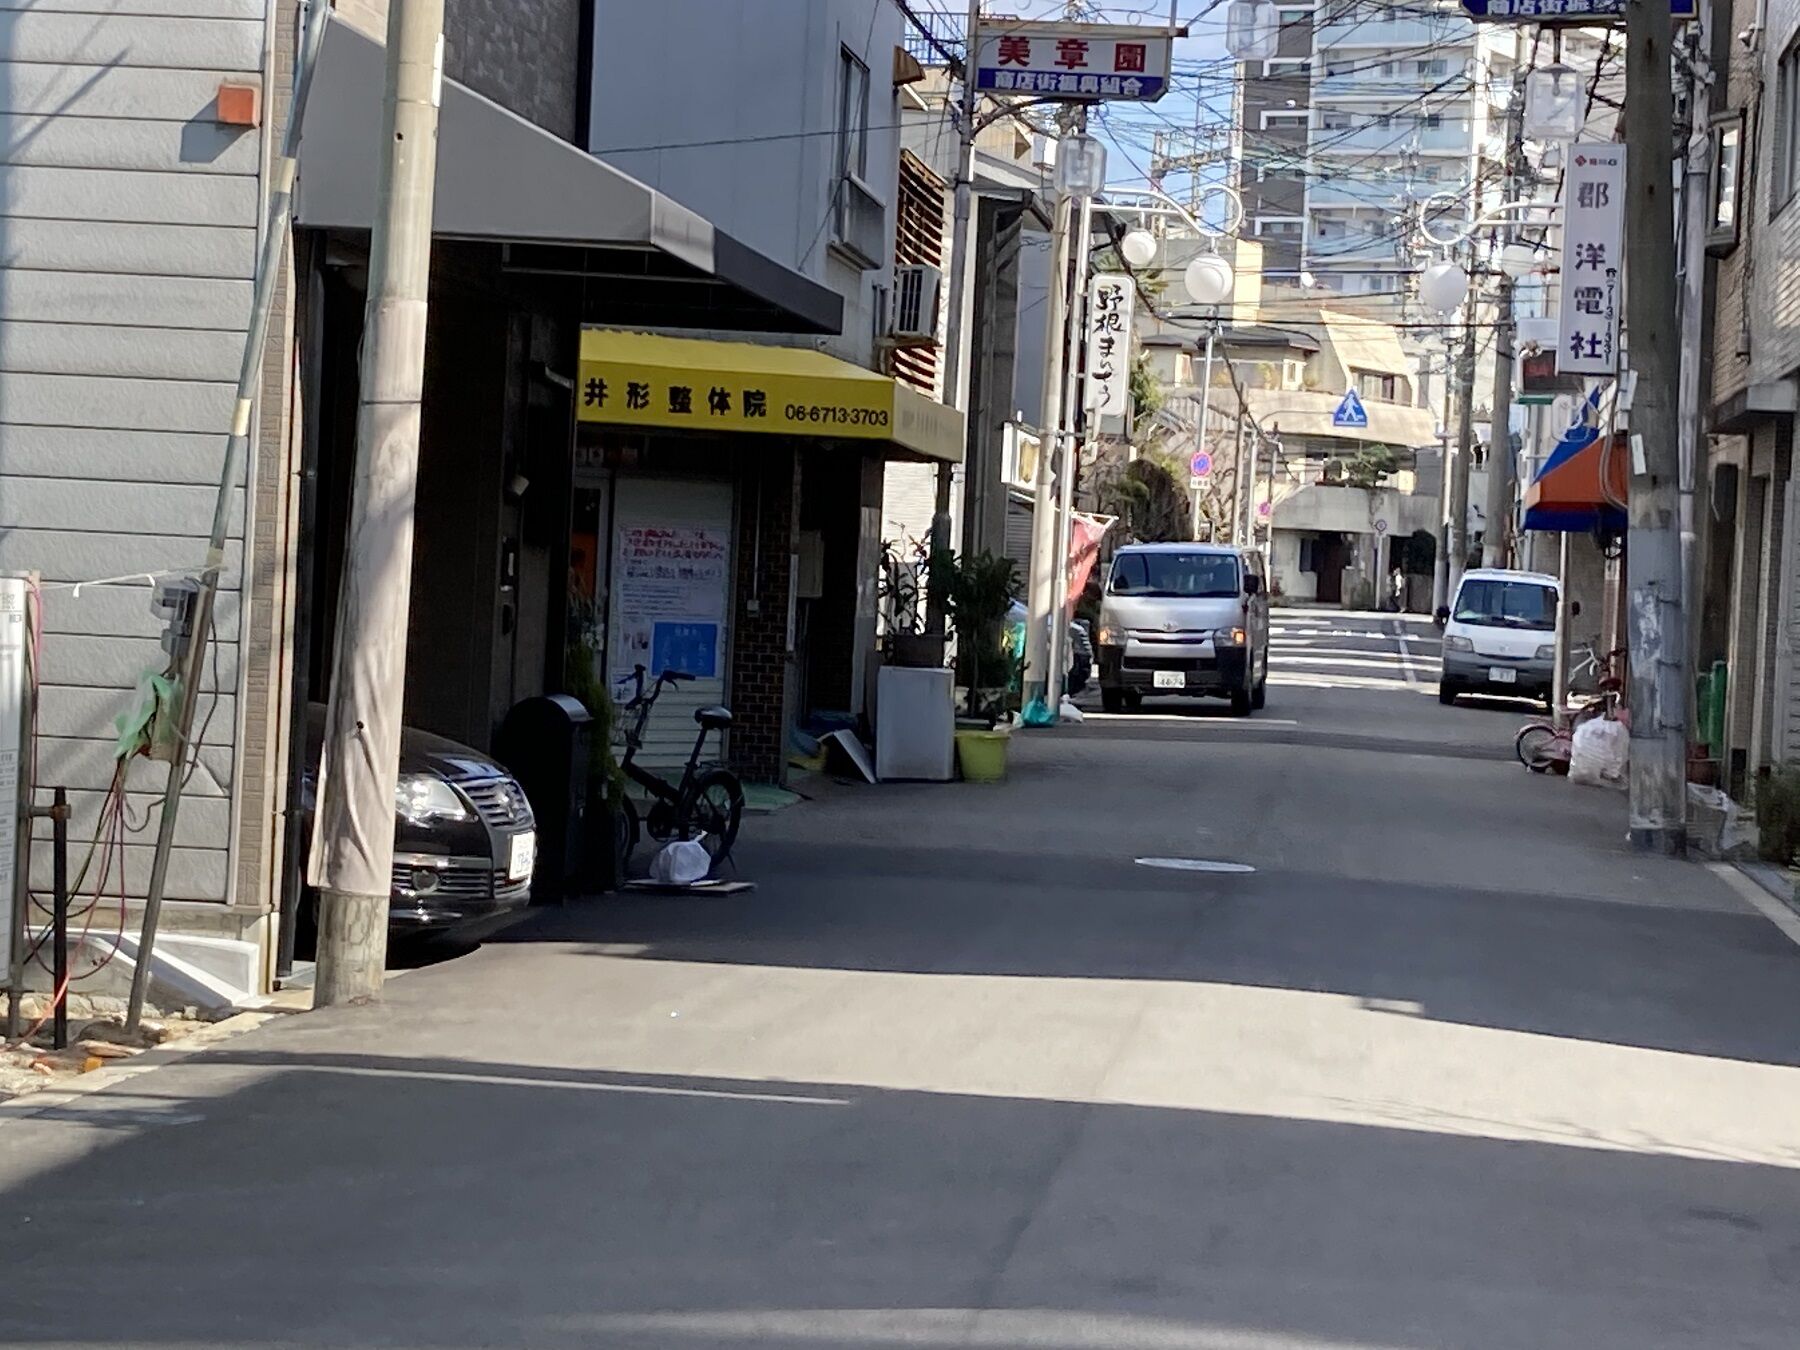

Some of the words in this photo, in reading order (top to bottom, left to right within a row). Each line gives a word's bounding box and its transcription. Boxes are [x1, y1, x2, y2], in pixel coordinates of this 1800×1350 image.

[1570, 182, 1609, 360] 郡洋電社
[583, 376, 768, 418] 井形整体院
[784, 403, 889, 427] 06-6713-3703
